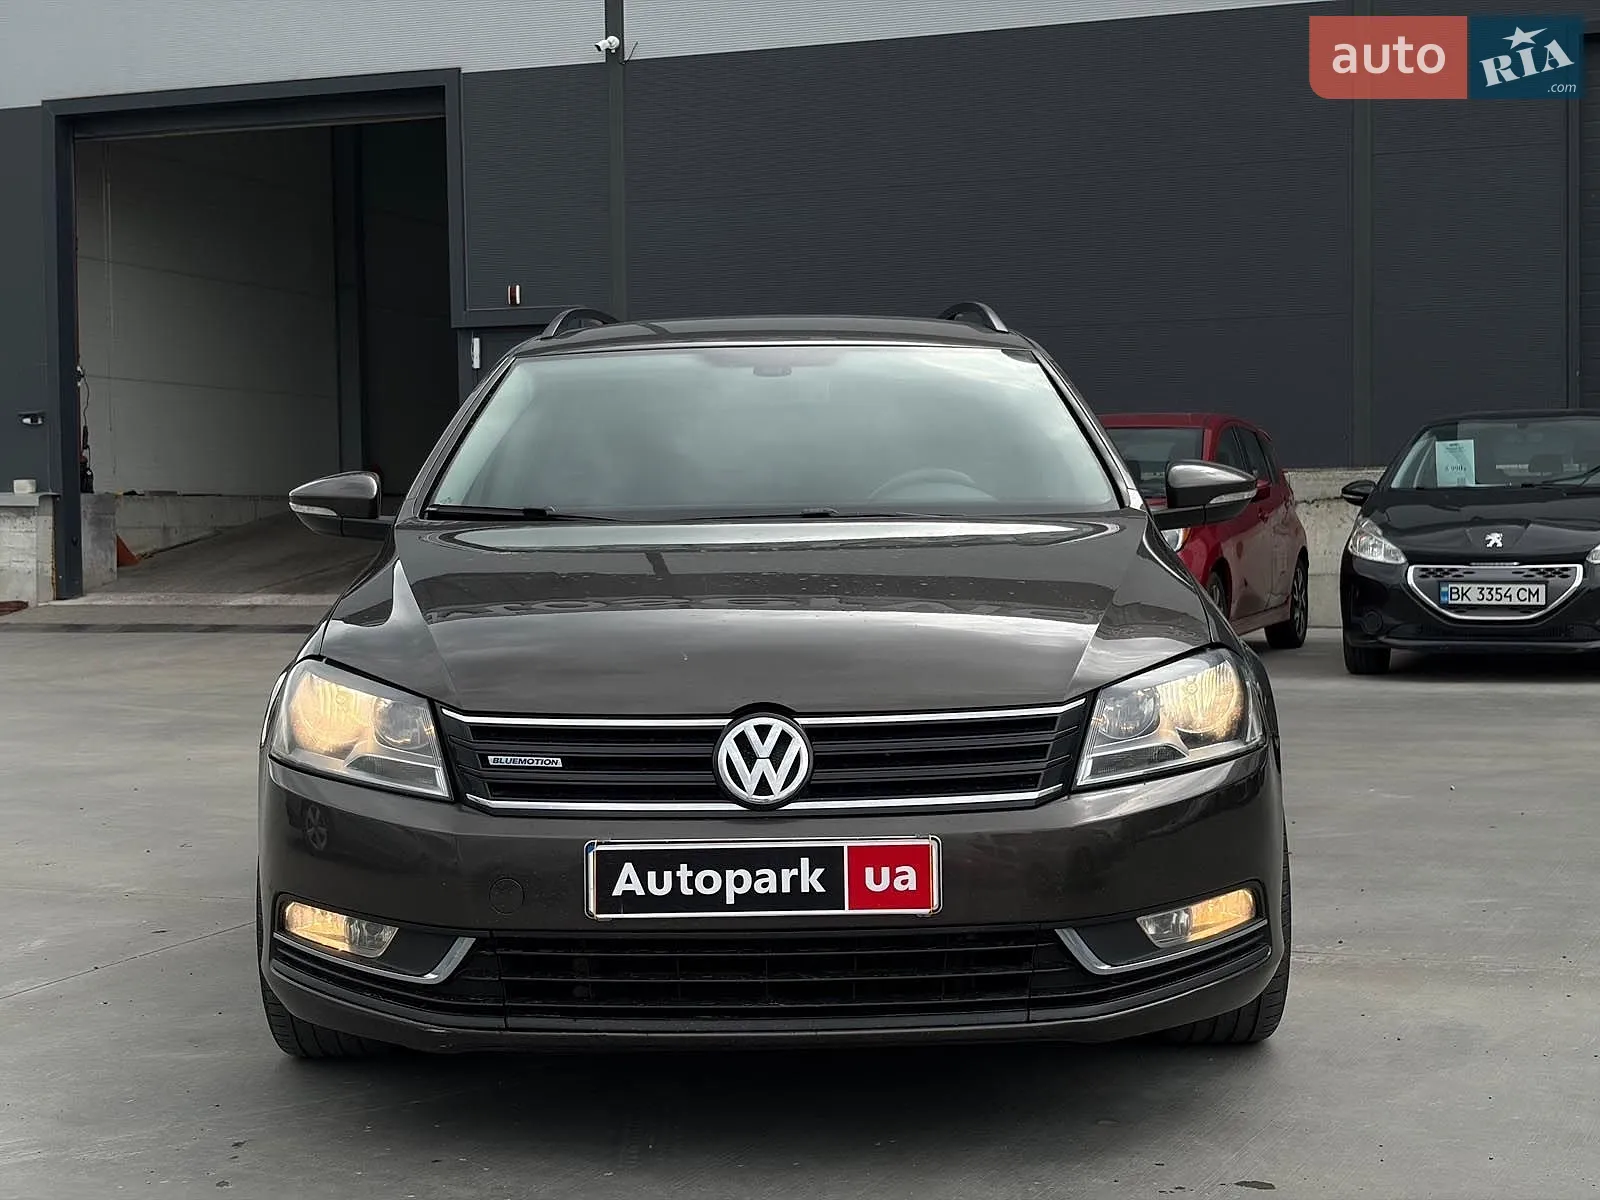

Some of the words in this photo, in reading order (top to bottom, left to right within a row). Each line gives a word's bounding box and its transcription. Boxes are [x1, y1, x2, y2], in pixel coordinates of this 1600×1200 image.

[1449, 586, 1472, 602] BK
[1477, 586, 1513, 603] 3354
[1516, 587, 1540, 603] CM
[492, 757, 559, 766] BLUEMOTION
[611, 857, 826, 905] Autopark
[864, 865, 918, 892] ua
